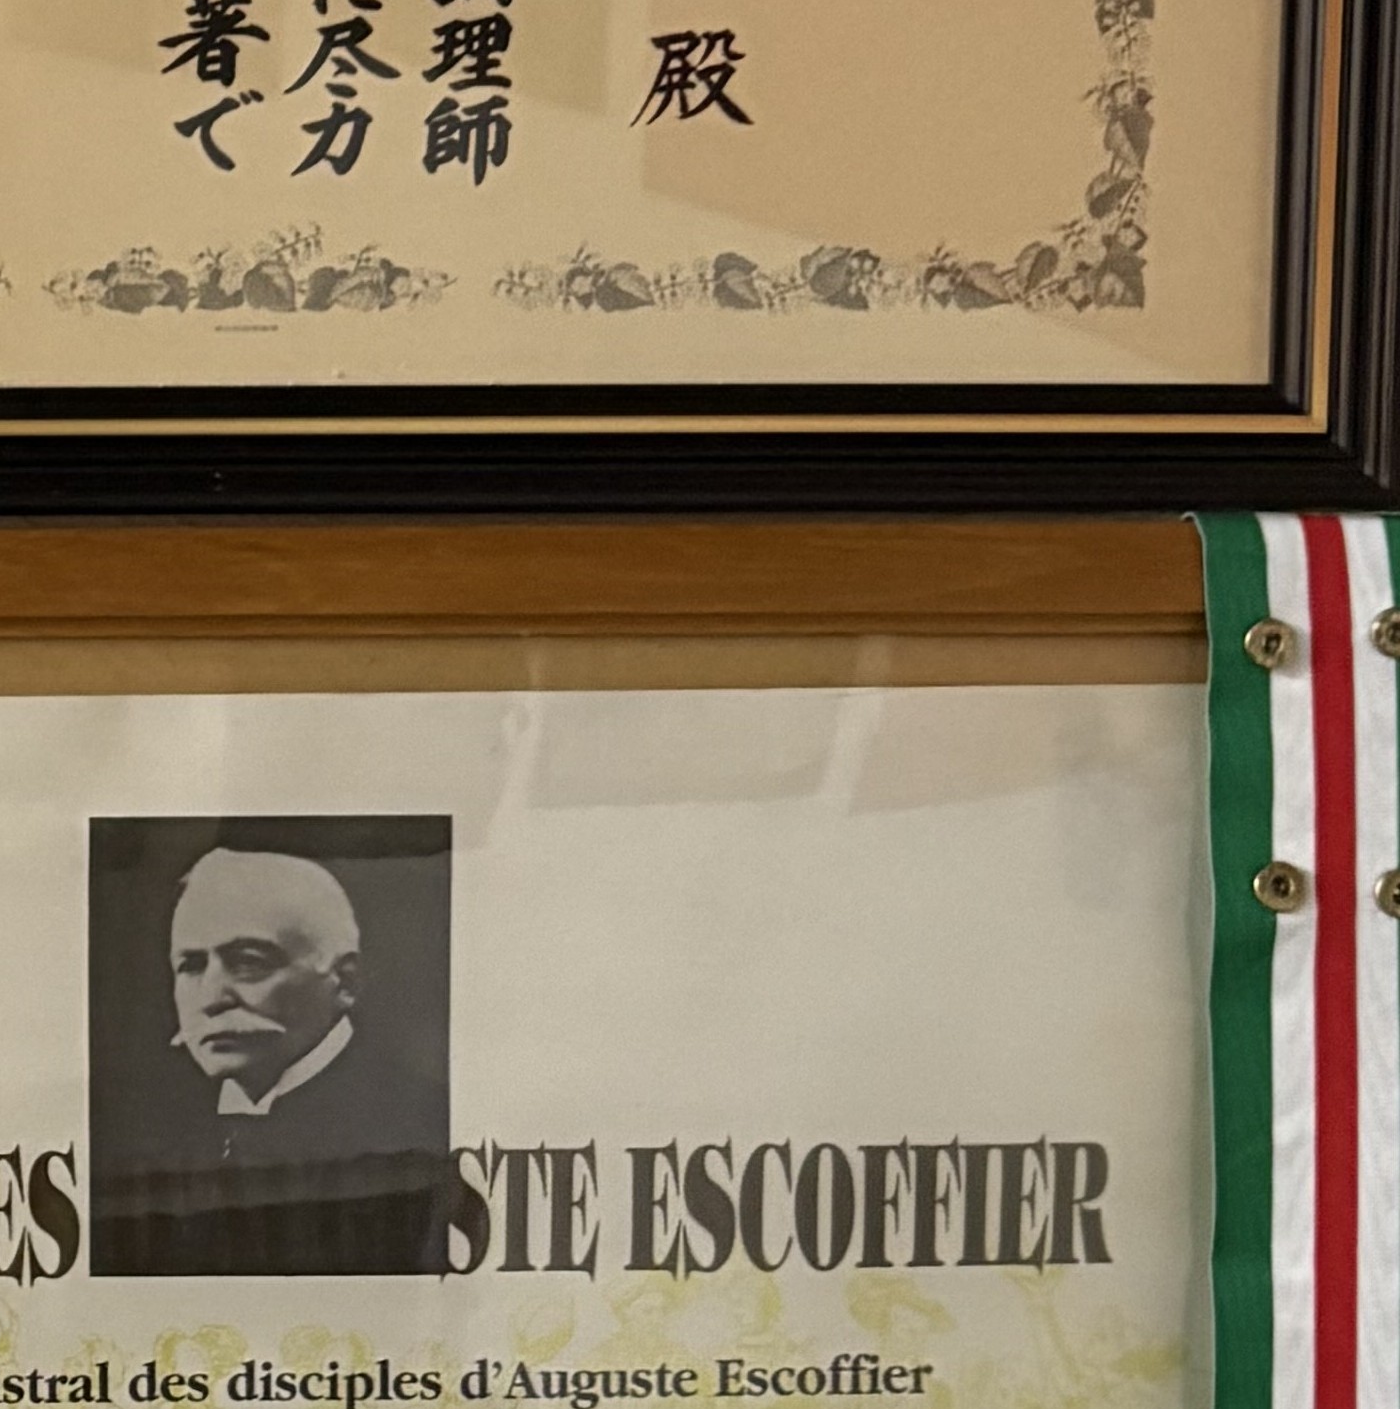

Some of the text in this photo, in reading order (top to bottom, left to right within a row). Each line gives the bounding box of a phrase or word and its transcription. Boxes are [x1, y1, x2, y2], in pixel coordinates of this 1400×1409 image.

[624, 1133, 1115, 1282] ESCOFFIER
[127, 1360, 211, 1405] des
[713, 1353, 935, 1400] Escoffier
